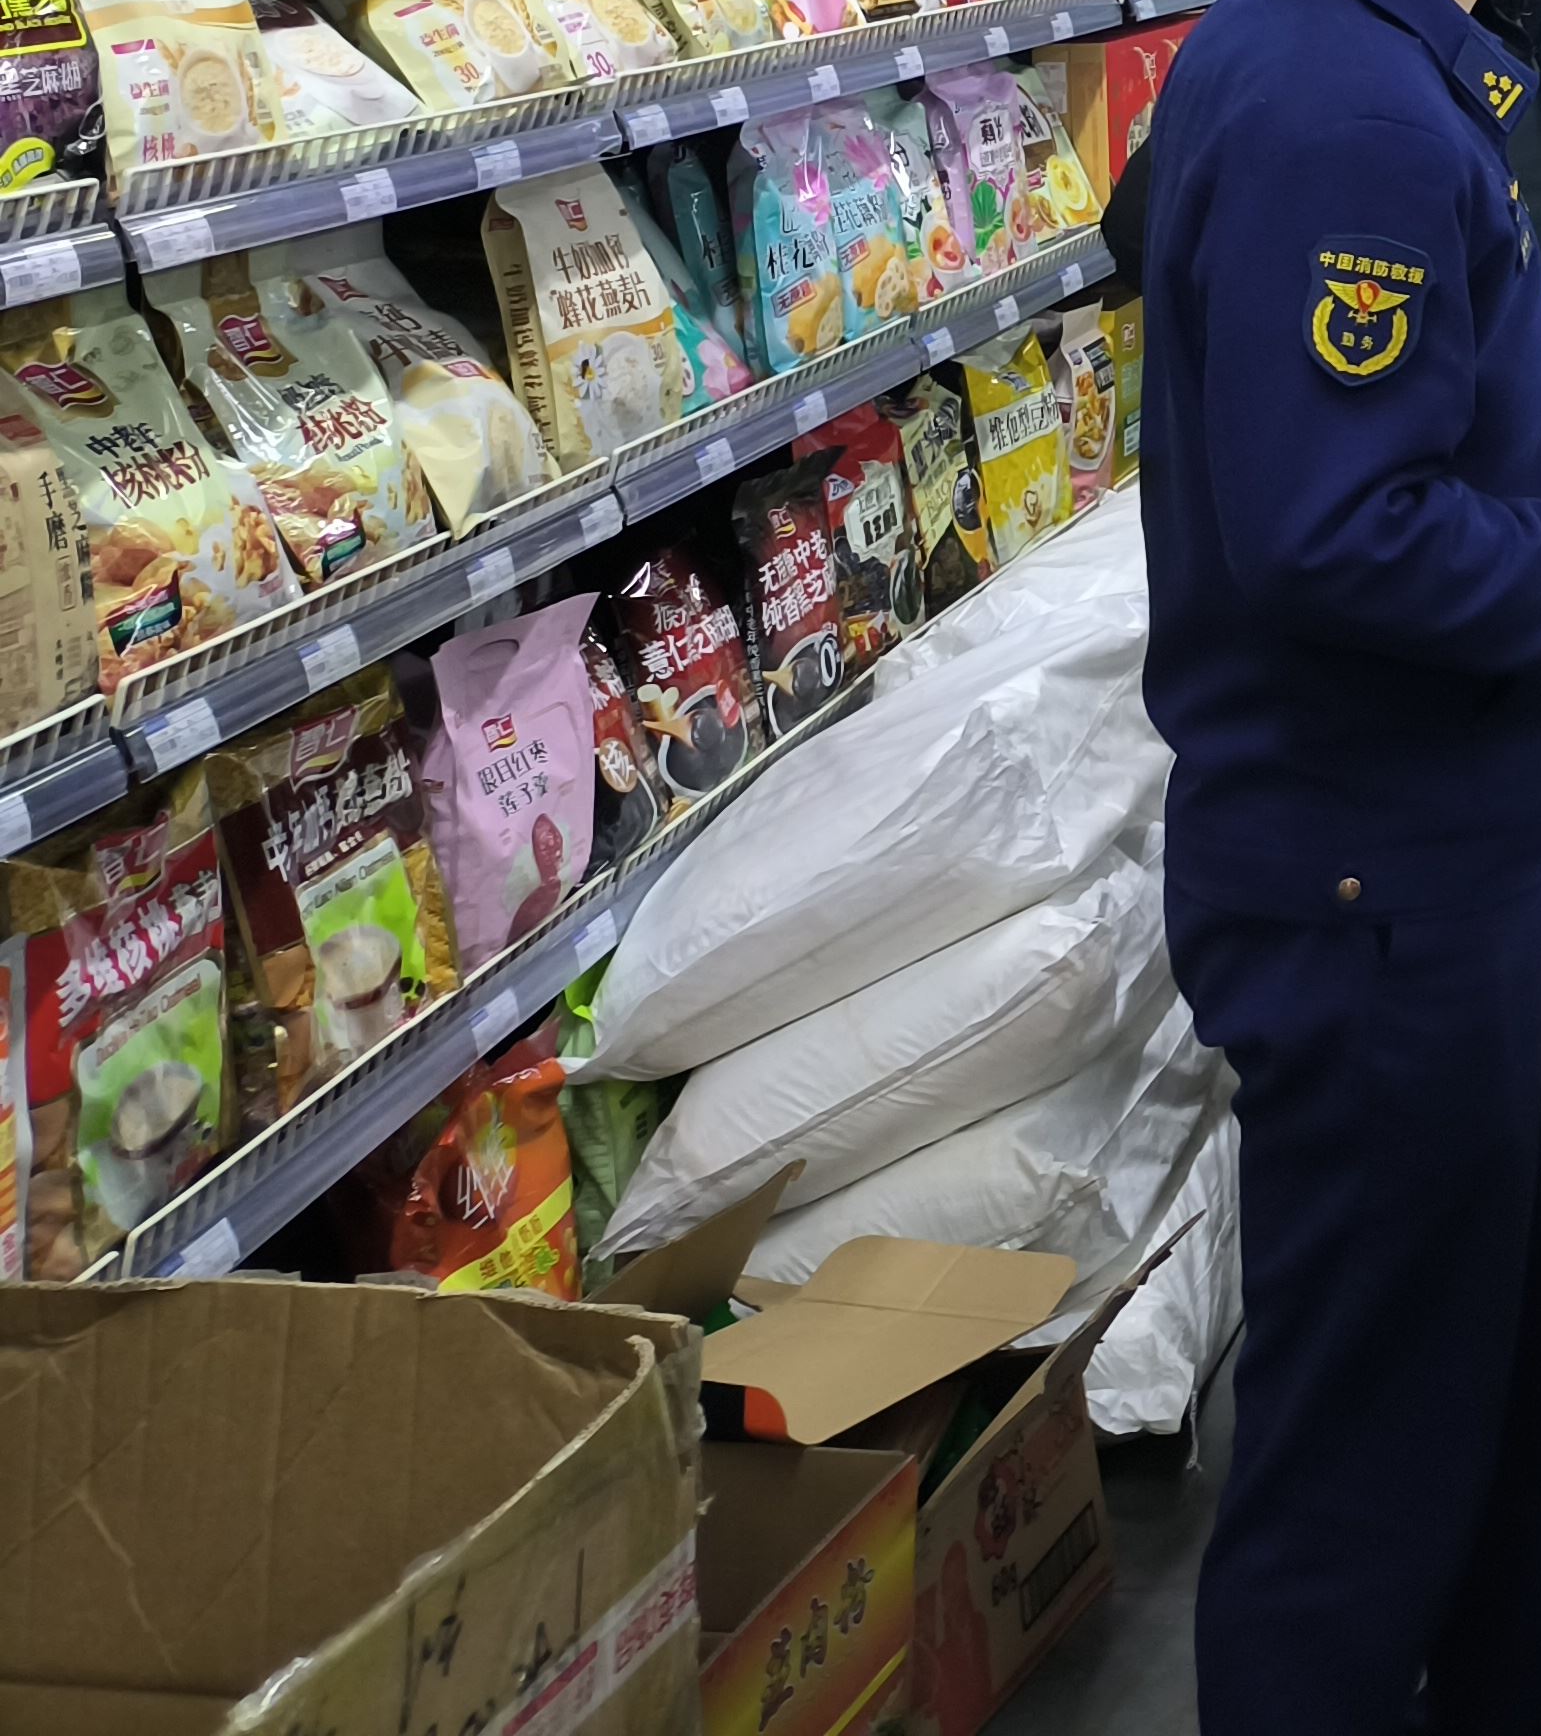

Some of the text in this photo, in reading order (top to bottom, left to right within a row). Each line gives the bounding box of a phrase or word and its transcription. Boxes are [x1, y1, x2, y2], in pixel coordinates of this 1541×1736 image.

[142, 132, 176, 164] 核桃
[1317, 248, 1426, 287] 中国消防救援
[1340, 331, 1376, 353] 勤务
[37, 471, 68, 553] 手磨
